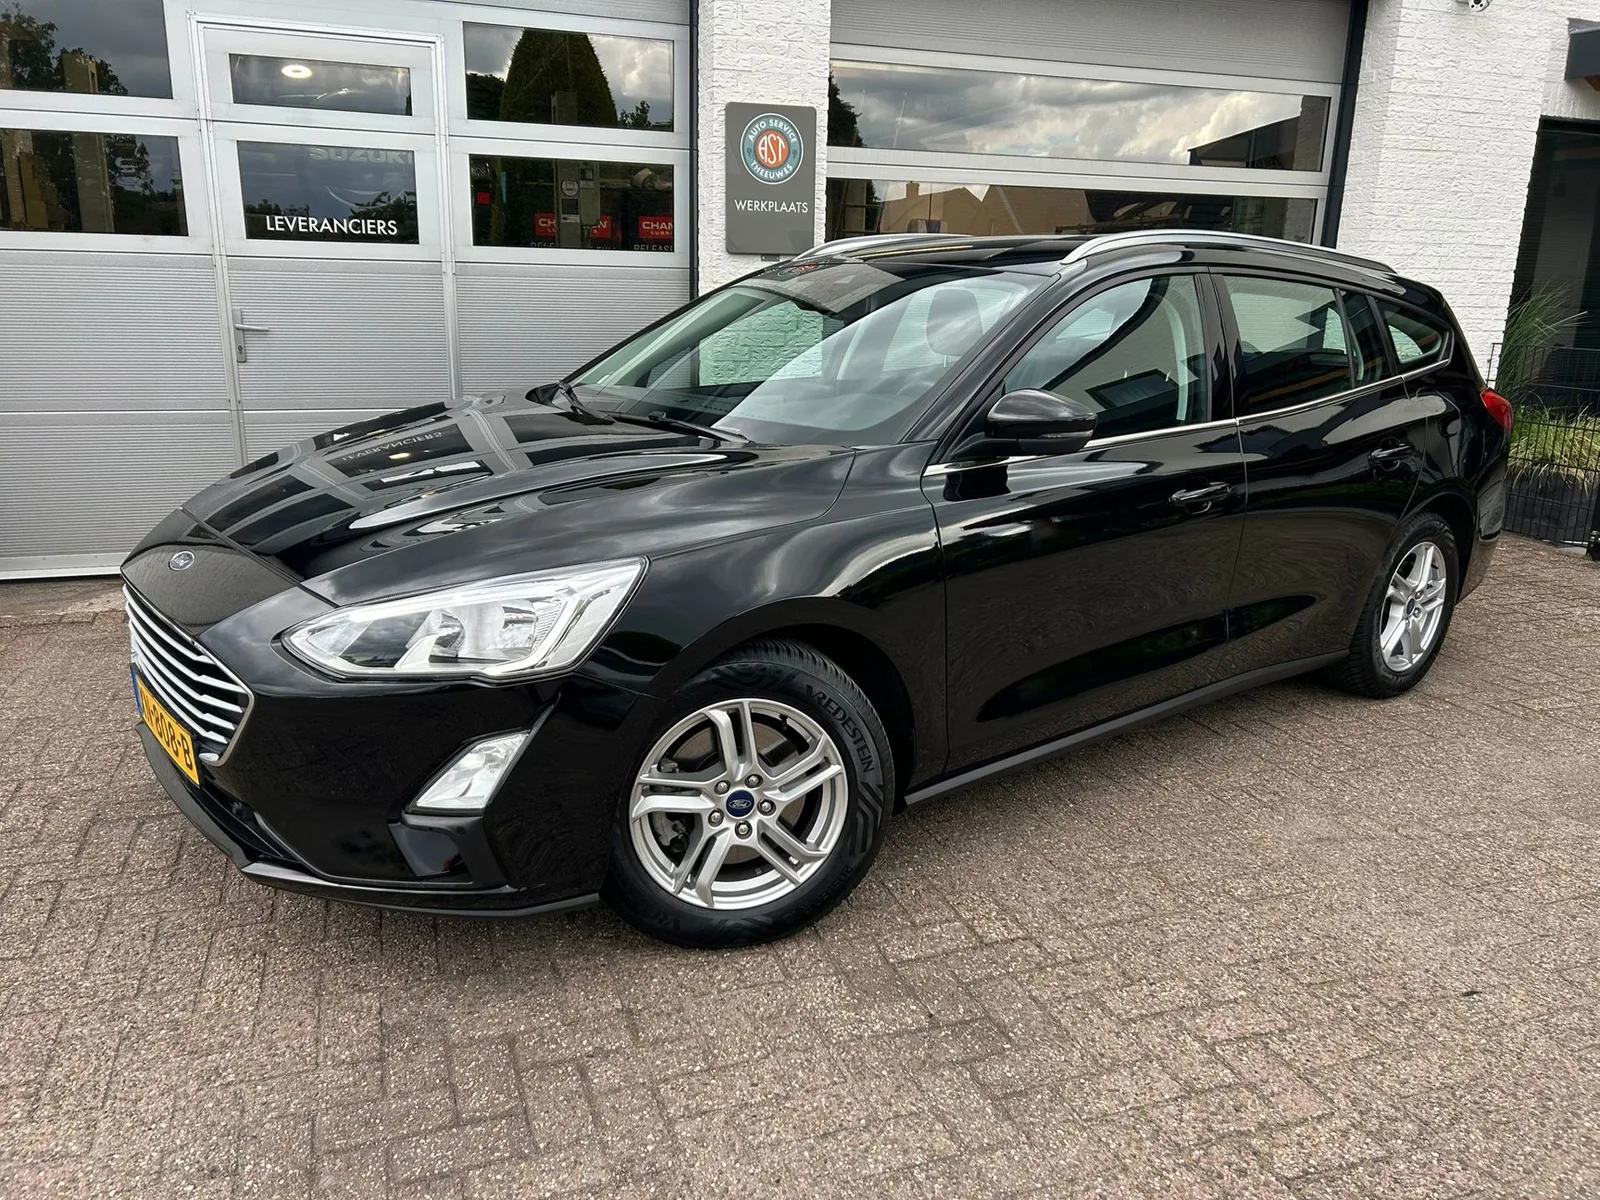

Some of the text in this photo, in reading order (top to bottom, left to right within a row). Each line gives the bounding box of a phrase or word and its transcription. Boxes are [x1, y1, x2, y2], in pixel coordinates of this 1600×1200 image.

[750, 119, 798, 144] AUTO SERVICE
[308, 147, 413, 165] SUZUKI
[758, 133, 785, 165] AST
[750, 160, 793, 179] THEEUWES
[734, 199, 809, 213] WERKPLAATS
[266, 215, 398, 236] LEVERANCIERS
[805, 684, 875, 773] VREDESTEIN
